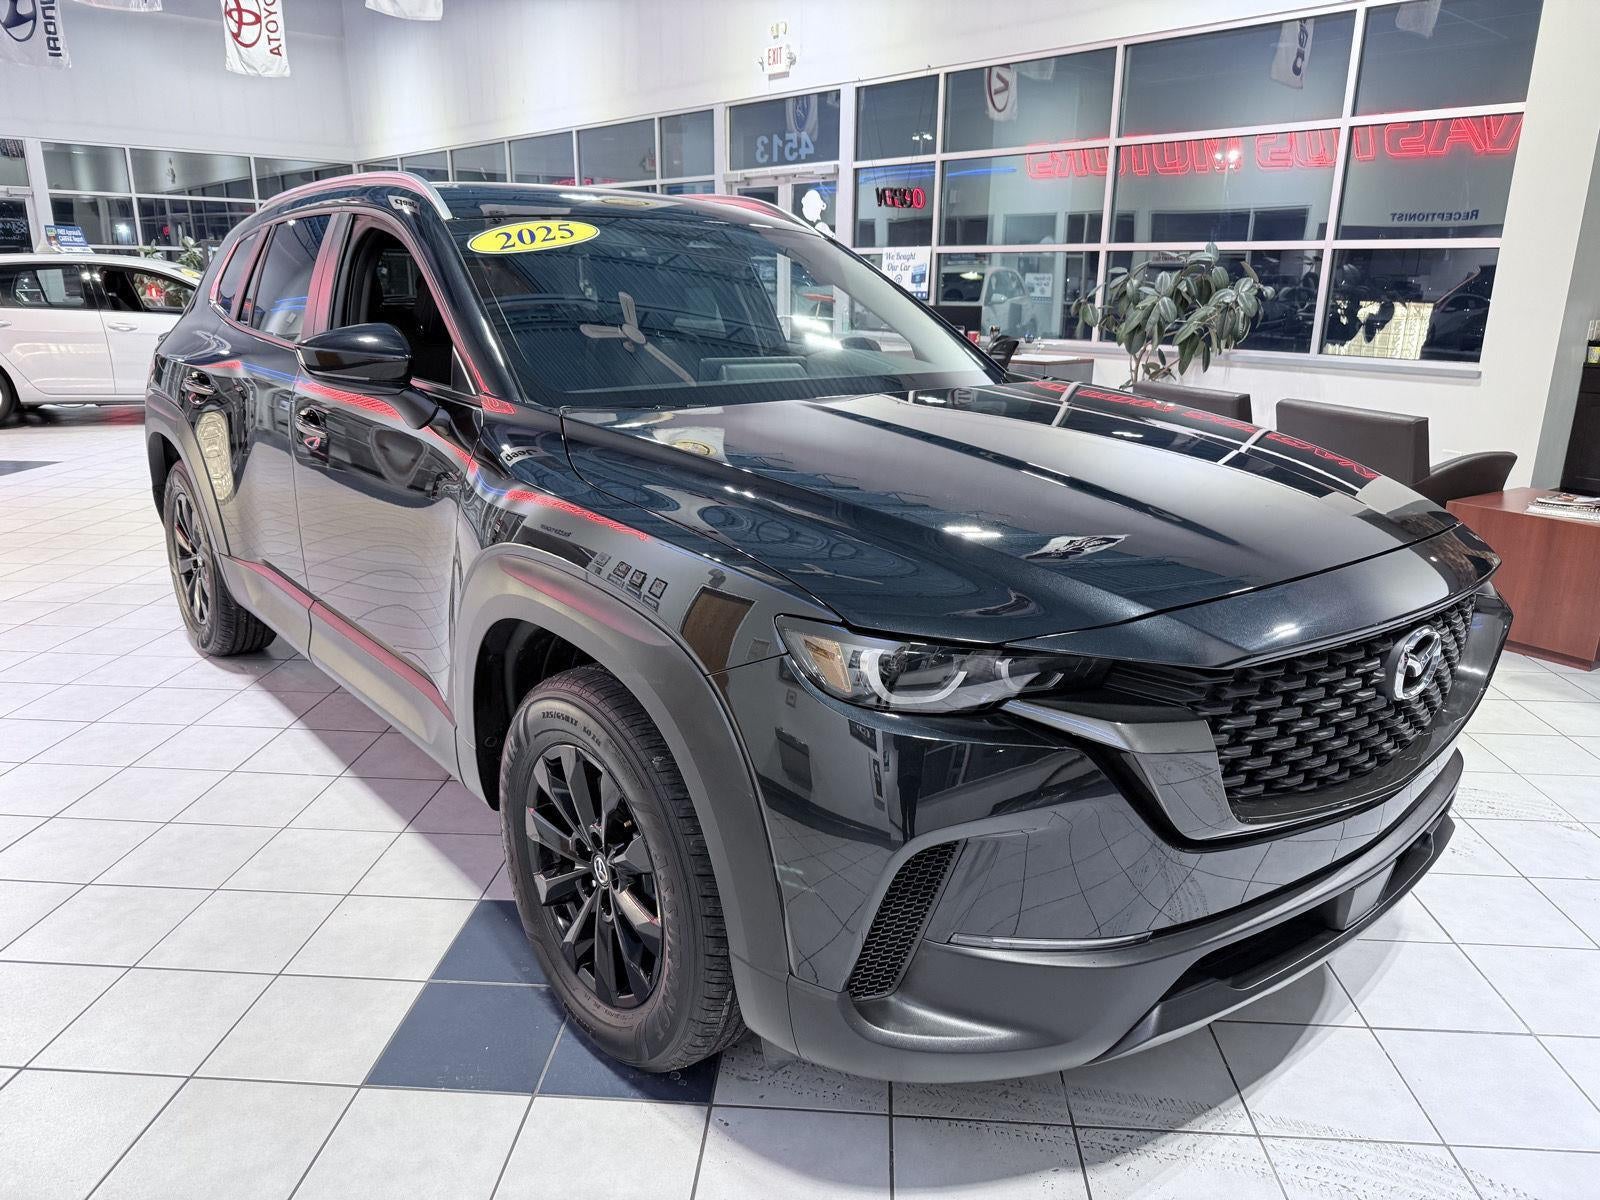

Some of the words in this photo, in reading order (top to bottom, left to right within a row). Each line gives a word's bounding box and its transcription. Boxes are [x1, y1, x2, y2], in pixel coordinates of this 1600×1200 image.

[767, 47, 783, 66] EXIT
[495, 223, 575, 250] 2025
[886, 252, 895, 260] We
[896, 252, 916, 261] Bought
[900, 263, 911, 271] Car
